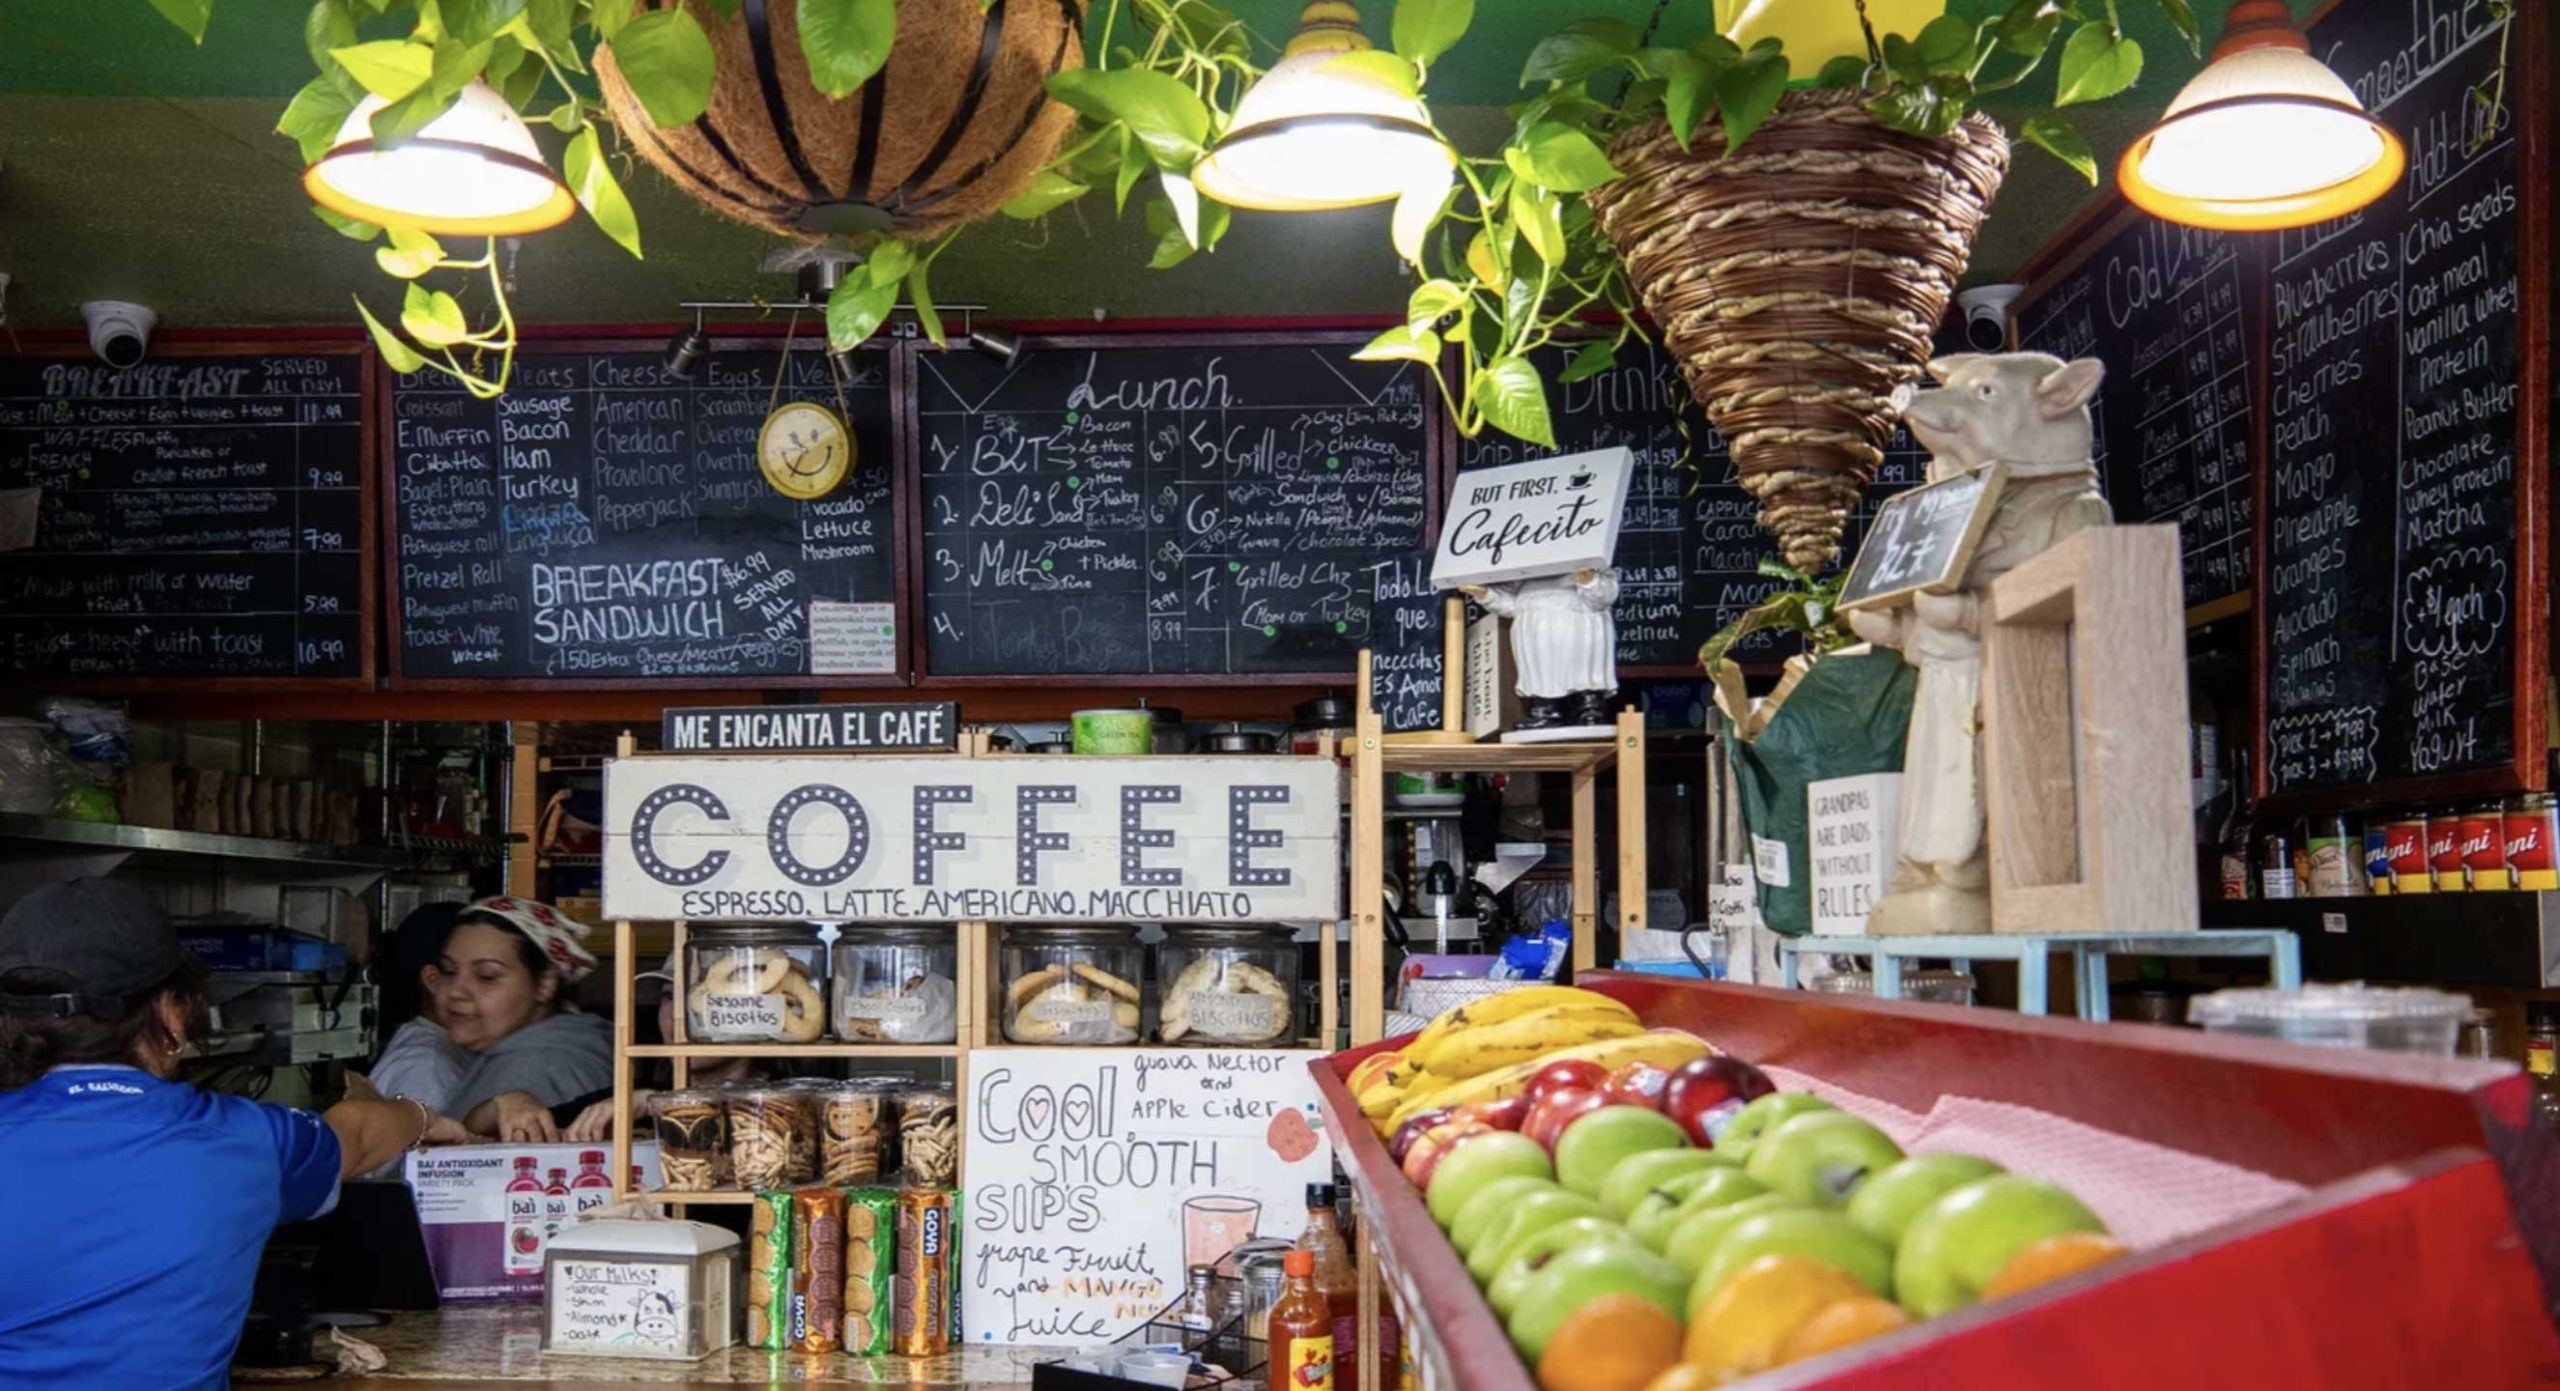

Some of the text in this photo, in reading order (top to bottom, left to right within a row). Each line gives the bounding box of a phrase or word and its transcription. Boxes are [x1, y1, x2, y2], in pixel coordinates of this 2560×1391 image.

[2405, 218, 2453, 264] Chia
[2458, 179, 2515, 233] Seeds
[2275, 241, 2390, 328] Blueberries
[2408, 242, 2488, 316] Oat meal
[2272, 281, 2398, 375] Strawberries
[41, 363, 250, 400] BREAKFAST
[261, 358, 328, 376] SERVED
[708, 361, 762, 392] Eggs
[262, 379, 292, 394] ALL
[2273, 349, 2362, 416] Cherries
[395, 394, 464, 417] Croissant
[500, 394, 574, 420] Sausage
[594, 397, 683, 423] American
[2405, 384, 2518, 441] Peanut Butter
[501, 420, 571, 442] Bacon
[1079, 414, 1132, 434] Bacon
[2274, 402, 2330, 460] Peach
[595, 428, 685, 454] Cheddar
[971, 433, 1050, 477] BLT
[503, 445, 551, 470] Ham
[596, 456, 685, 488] Provolone
[2400, 432, 2495, 489] Chocolate
[308, 466, 343, 489] 9.99
[450, 475, 494, 497] Plain
[500, 473, 578, 500] Turkey
[2275, 452, 2335, 508] Mango
[801, 499, 865, 517] Avocado
[1471, 483, 1506, 506] BUT
[303, 528, 343, 550] 7.99
[802, 519, 874, 541] Lettuce
[1450, 494, 1604, 565] Cafecito
[2274, 494, 2360, 554] Pineapple
[2406, 502, 2485, 550] Matcha
[475, 528, 499, 552] roll
[801, 542, 875, 561] Mushroom
[403, 560, 502, 590] Pretzel Roll
[721, 551, 772, 590] $6.99
[970, 539, 1029, 588] Melt
[2272, 538, 2346, 594] Oranges
[197, 573, 255, 591] water
[533, 558, 724, 607] BREAKFAST
[733, 568, 796, 611] SERVED
[1236, 560, 1306, 601] Grilled
[534, 599, 724, 644] SANDWICH
[760, 597, 794, 621] ALL
[2272, 588, 2338, 646] Avocado
[155, 626, 263, 654] with toast
[1151, 619, 1182, 641] 8.99
[299, 640, 344, 665] 10.99
[2279, 635, 2340, 682] Spinach
[1400, 672, 1442, 700] Amor
[674, 705, 944, 748] ME ENCANTA EL CAFÉ
[2411, 716, 2477, 773] Yogurt
[1815, 789, 1870, 818] GRANDPAS
[631, 783, 1291, 886] COFFEE
[1816, 822, 1870, 847] ARE DADS
[1816, 853, 1871, 877] WITHOUT
[1089, 889, 1251, 917] MACCHIATO
[1818, 884, 1872, 918] RULES
[1134, 1054, 1197, 1091] guava
[978, 1065, 1117, 1143] Cool
[1203, 1100, 1278, 1118] Cider
[418, 1158, 503, 1169] BAI ANTIOXIDANT
[418, 1170, 465, 1179] INFUSION
[1031, 1140, 1217, 1187] SMOOTH
[512, 1199, 536, 1214] bai
[547, 1202, 566, 1213] bai
[925, 1209, 938, 1254] GOYA
[976, 1243, 1050, 1288] grape
